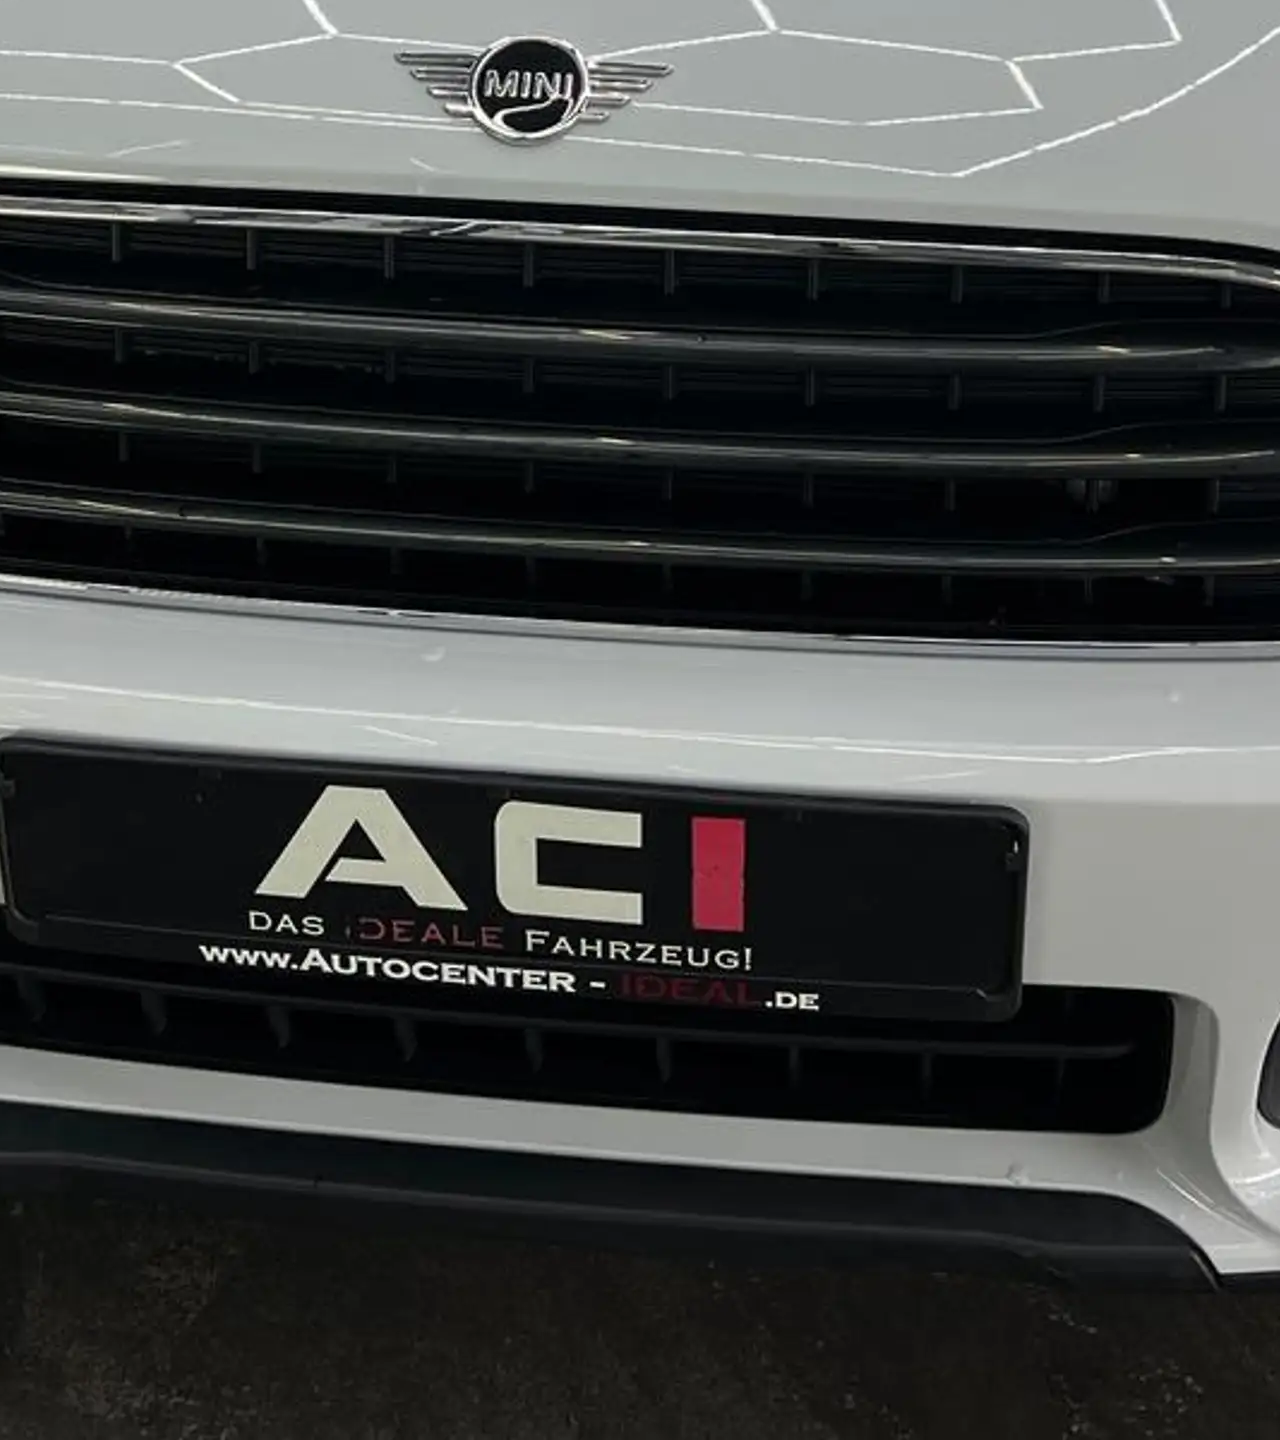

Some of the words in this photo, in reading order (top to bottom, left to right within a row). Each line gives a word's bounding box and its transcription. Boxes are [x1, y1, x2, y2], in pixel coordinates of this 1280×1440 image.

[483, 68, 575, 101] MINI
[248, 910, 325, 936] DAS
[524, 929, 752, 972] FAHRZEUG!
